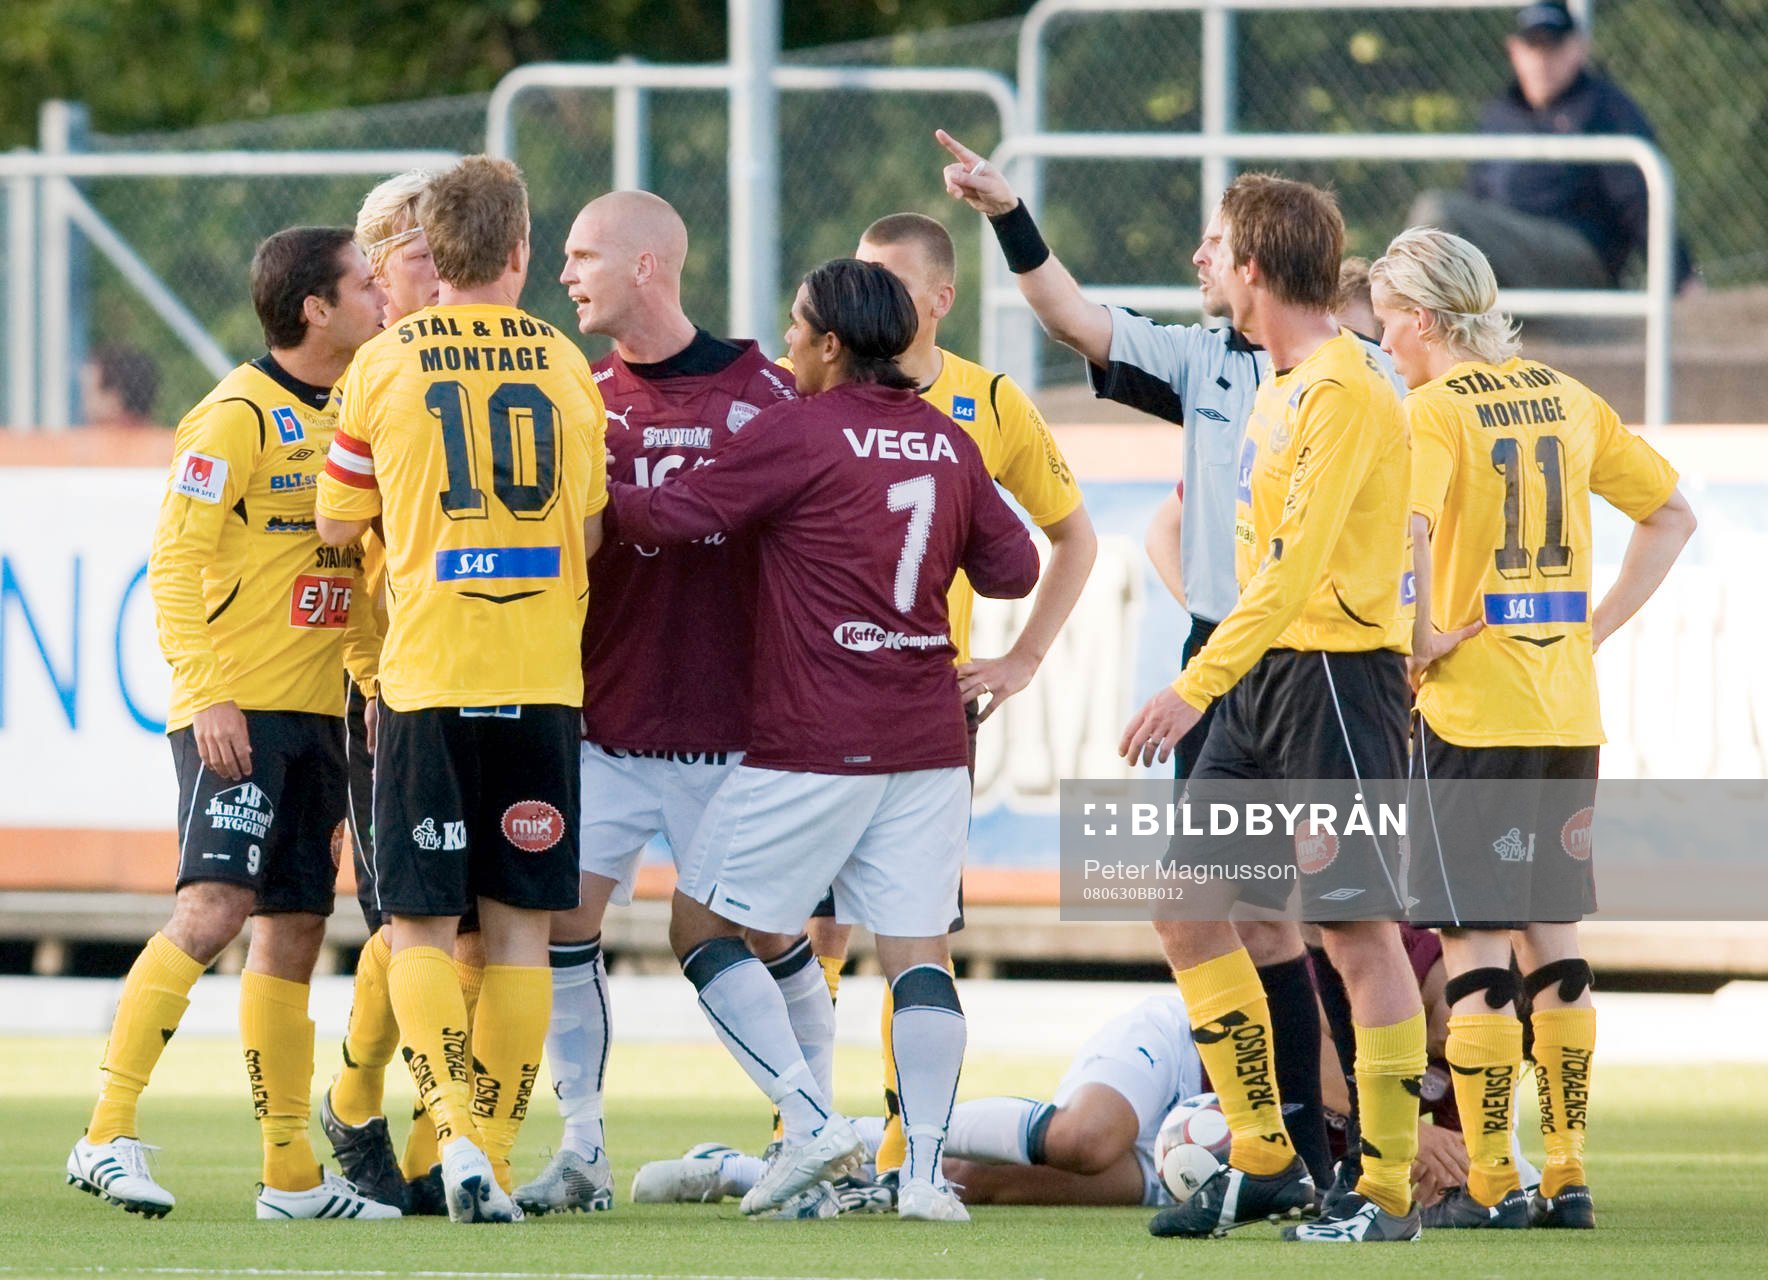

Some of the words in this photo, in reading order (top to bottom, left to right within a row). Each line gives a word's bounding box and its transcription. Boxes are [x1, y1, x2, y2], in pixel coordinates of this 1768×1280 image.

[398, 315, 462, 344] STÅL
[473, 321, 491, 337] &
[420, 346, 550, 372] MONTAGE
[1446, 369, 1506, 395] STÅL
[1505, 374, 1523, 389] &
[954, 406, 974, 417] SAS
[1476, 396, 1567, 428] MONTAGE
[424, 380, 563, 522] 10
[643, 427, 713, 449] STADIUM
[842, 428, 959, 463] VEGA
[1491, 435, 1574, 581] 11
[886, 473, 937, 614] 7
[455, 553, 498, 575] SAS
[1504, 598, 1536, 620] SAS
[512, 816, 553, 834] mix
[247, 843, 261, 876] 9
